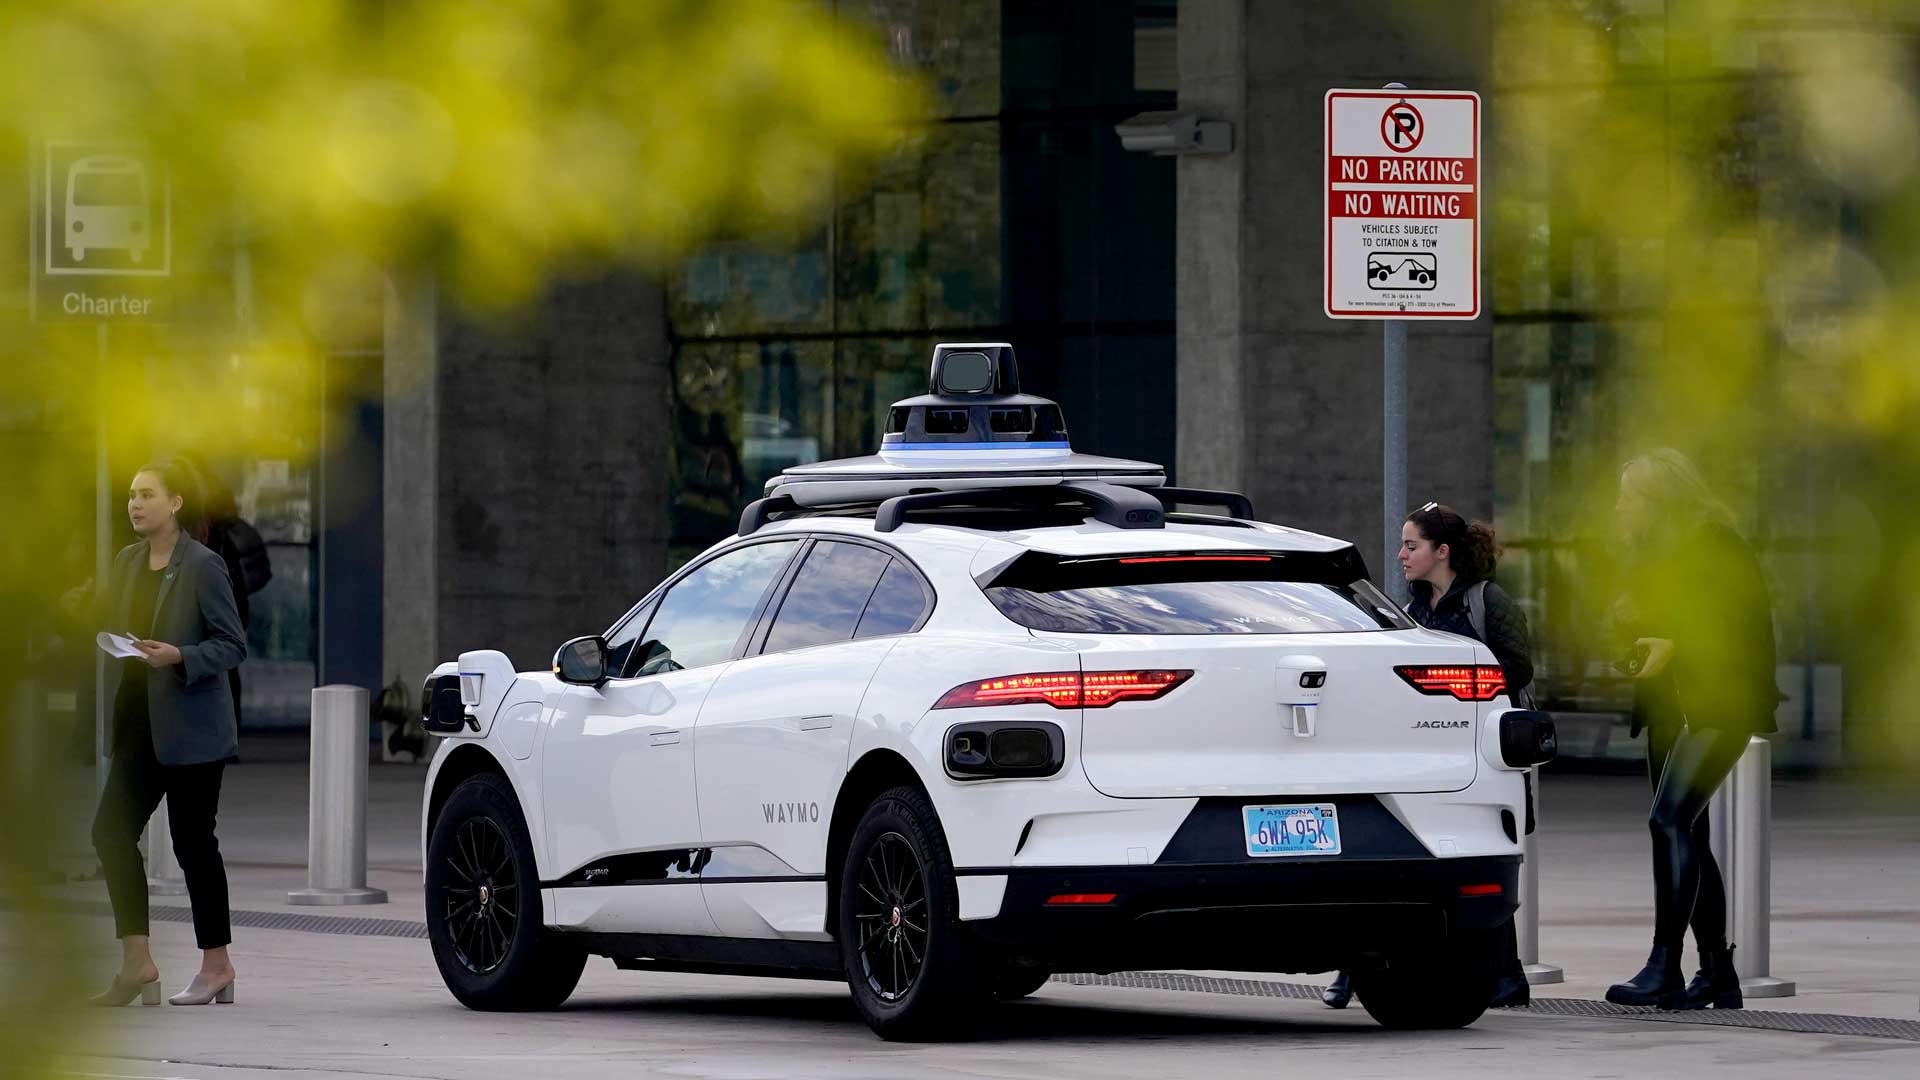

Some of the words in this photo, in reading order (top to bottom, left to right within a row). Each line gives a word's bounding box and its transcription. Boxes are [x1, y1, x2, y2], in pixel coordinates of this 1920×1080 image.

[1341, 158, 1368, 180] NO
[1379, 159, 1464, 182] PARKING
[1345, 193, 1372, 215] NO
[1381, 194, 1460, 216] WAITING
[1361, 224, 1400, 234] VEHICLES
[1403, 224, 1438, 235] SUBJECT
[1362, 238, 1372, 247] TO
[1375, 238, 1409, 248] CITATION
[1411, 238, 1418, 248] &
[1421, 239, 1438, 248] TOW
[63, 292, 152, 315] Charter
[1233, 615, 1312, 624] WAYMO
[1410, 720, 1470, 729] JAGUAR
[762, 802, 819, 824] WAYMO
[1266, 808, 1314, 816] ARIZONA
[1258, 820, 1290, 845] 6WA
[1296, 819, 1329, 845] 95K
